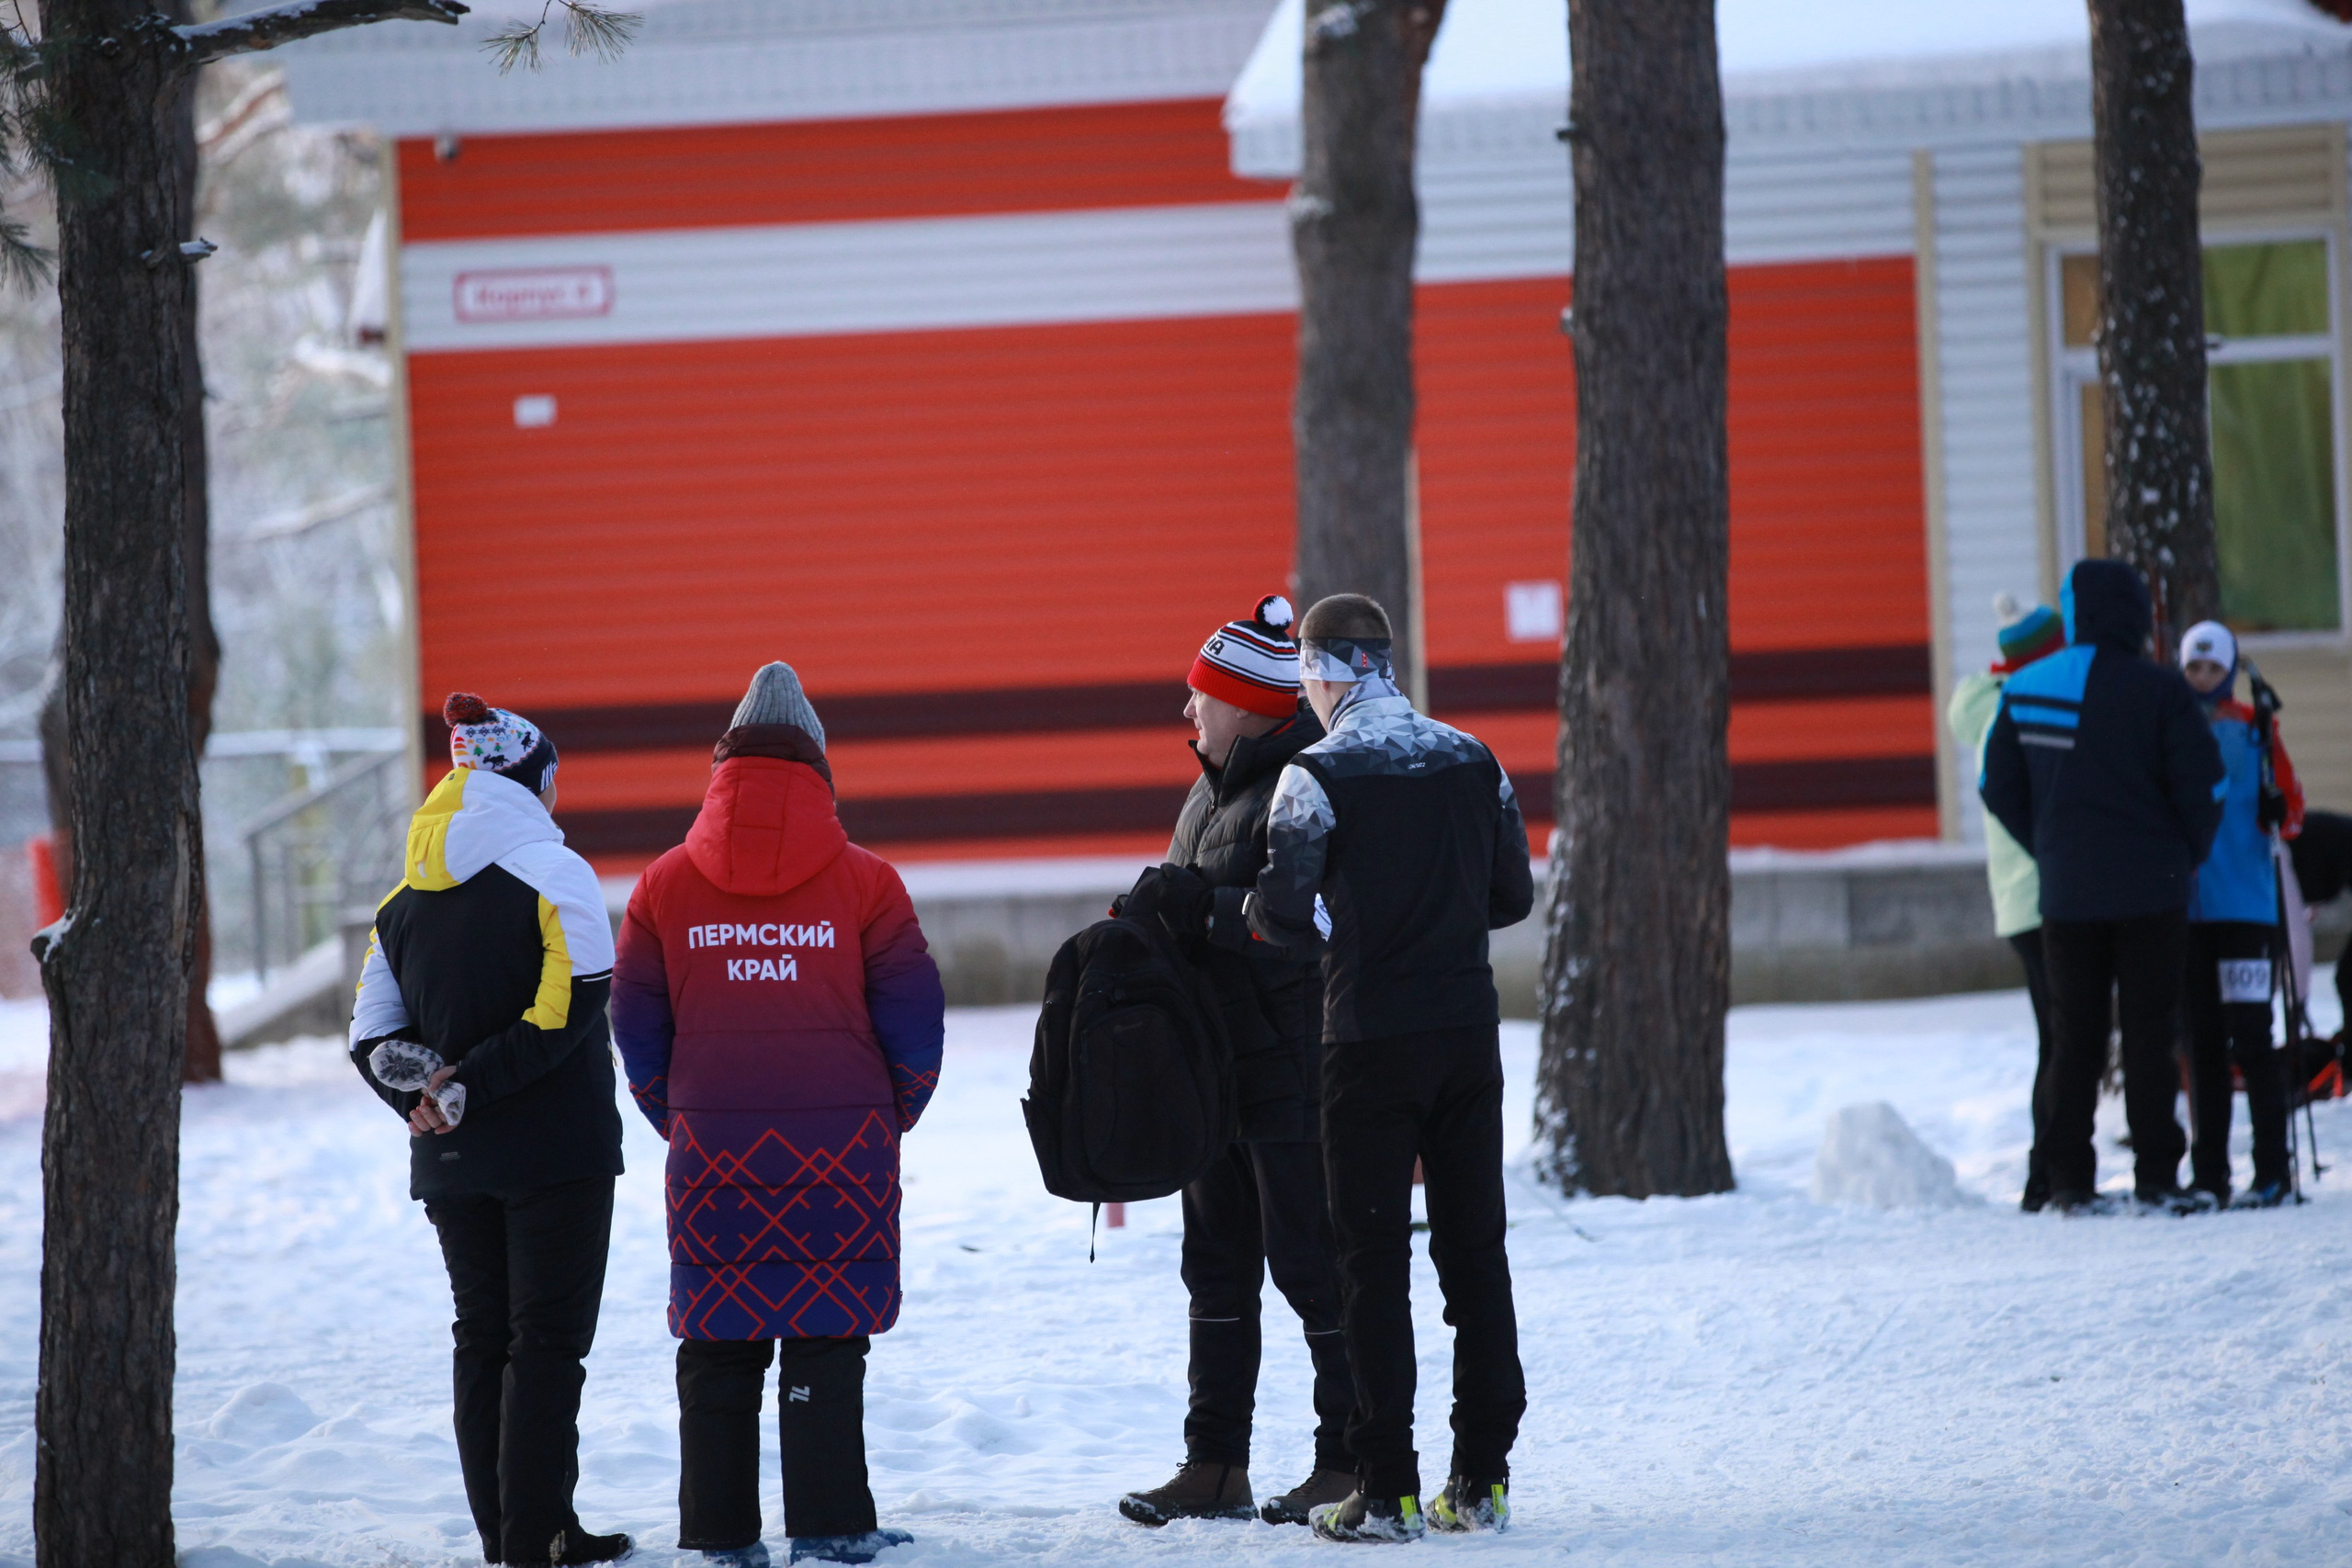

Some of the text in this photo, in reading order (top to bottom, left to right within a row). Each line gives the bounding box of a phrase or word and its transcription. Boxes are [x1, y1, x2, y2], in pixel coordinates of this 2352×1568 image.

[1205, 637, 1226, 656] IA
[688, 920, 835, 949] ПЕРМСКИЙ
[727, 953, 797, 981] КРАЙ
